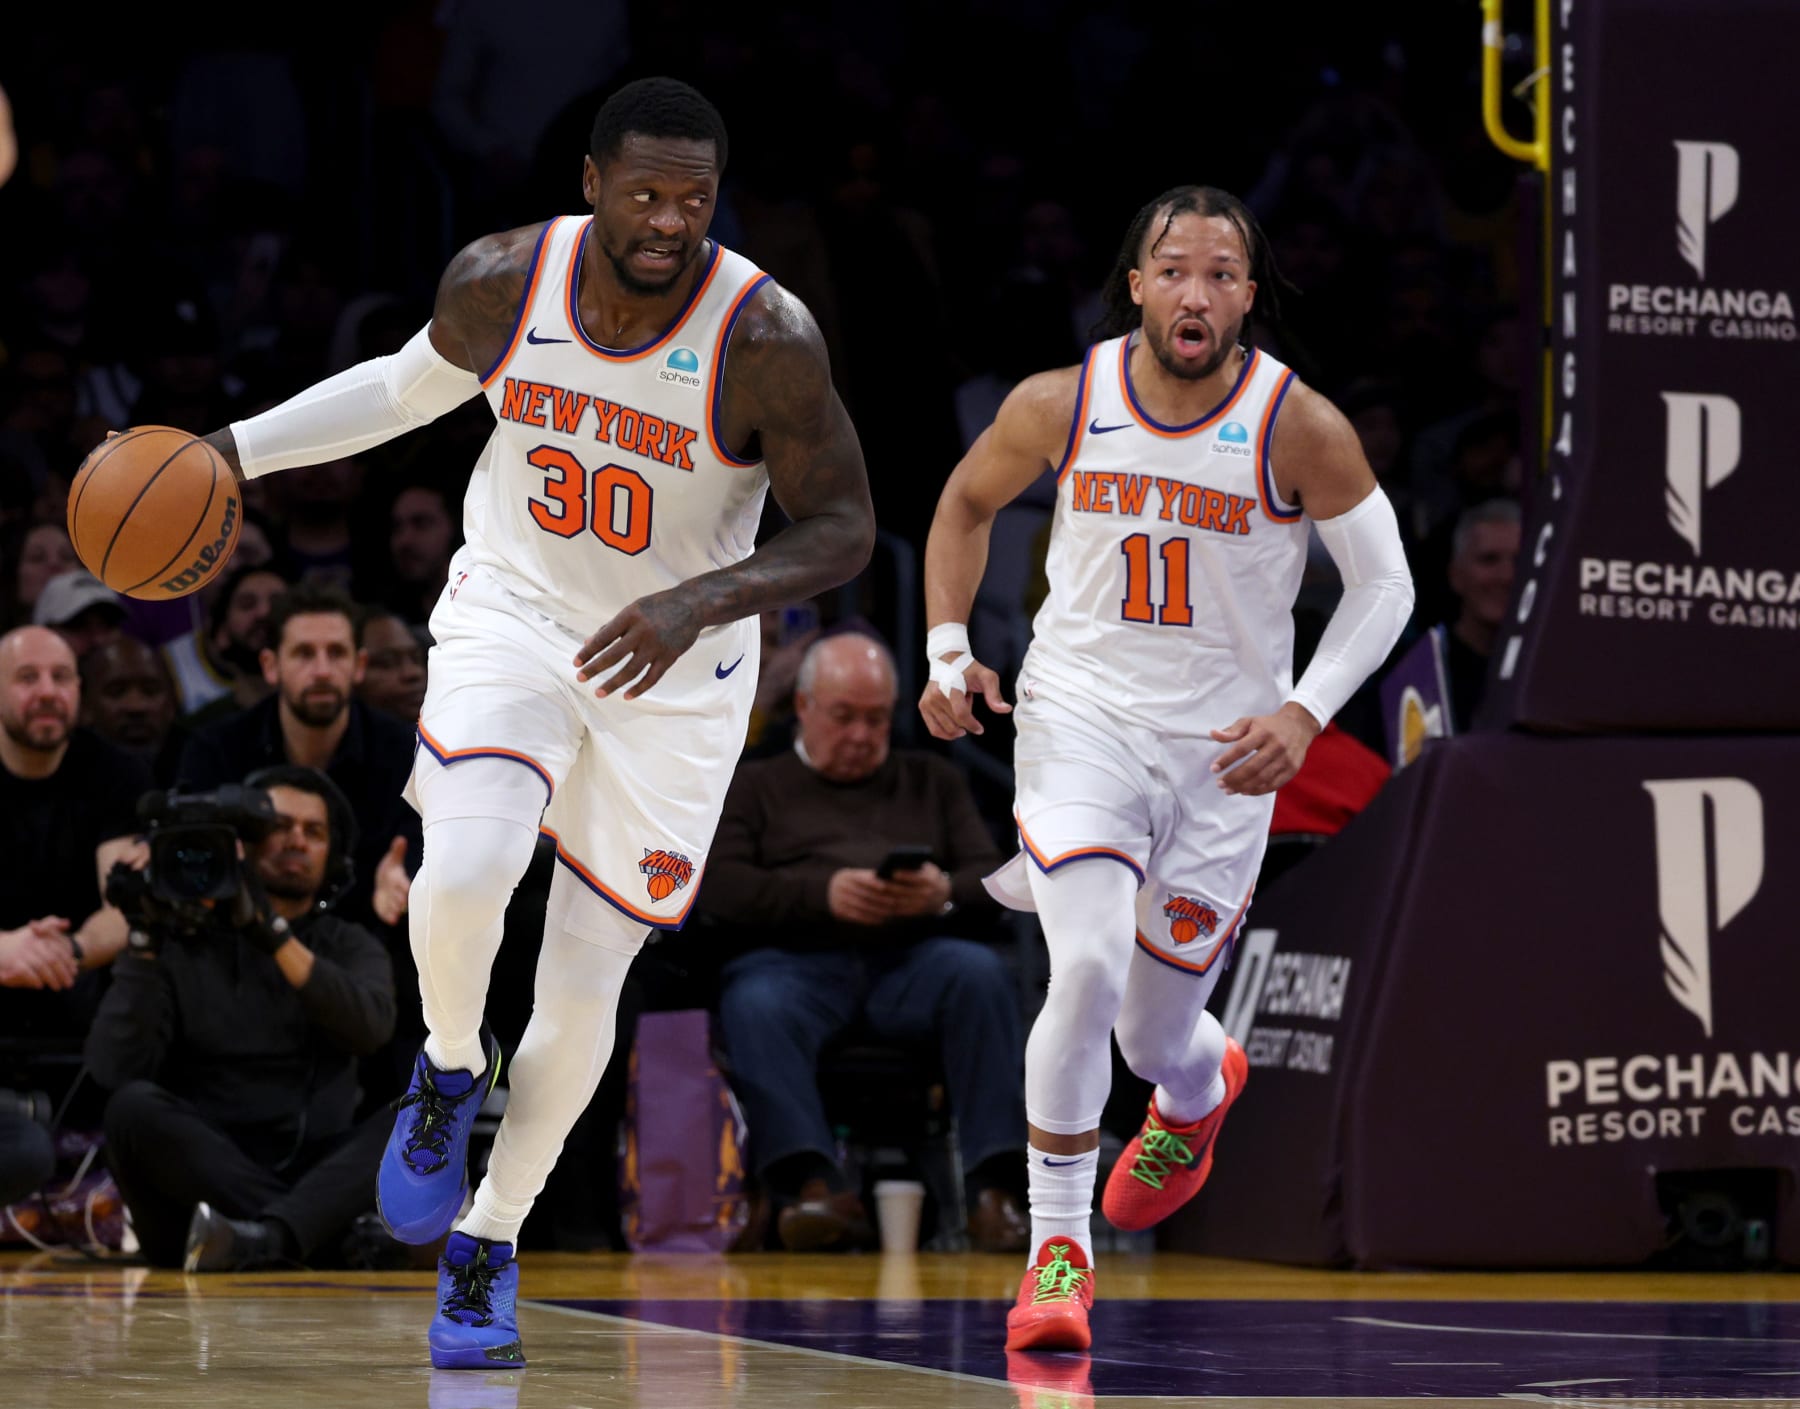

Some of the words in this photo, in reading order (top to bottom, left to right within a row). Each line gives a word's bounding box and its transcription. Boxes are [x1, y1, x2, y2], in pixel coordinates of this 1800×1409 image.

[1608, 284, 1794, 320] PECHANGA
[1608, 313, 1697, 336] RESORT
[1709, 318, 1797, 341] CASINO
[659, 370, 700, 387] sphere
[500, 377, 590, 436] NEW
[593, 395, 699, 472] YORK
[1211, 443, 1251, 457] sphere
[526, 443, 654, 557] 30
[1072, 470, 1153, 517] NEW
[1155, 476, 1257, 536] YORK
[159, 495, 237, 593] Wilson
[1121, 532, 1194, 628] 11
[1579, 593, 1694, 622] RESORT
[1708, 602, 1800, 630] CASIN
[638, 849, 693, 886] KNICKS
[1546, 1051, 1800, 1108] PECHAN
[1548, 1106, 1707, 1147] RESORT
[1729, 1105, 1800, 1137] CAS
